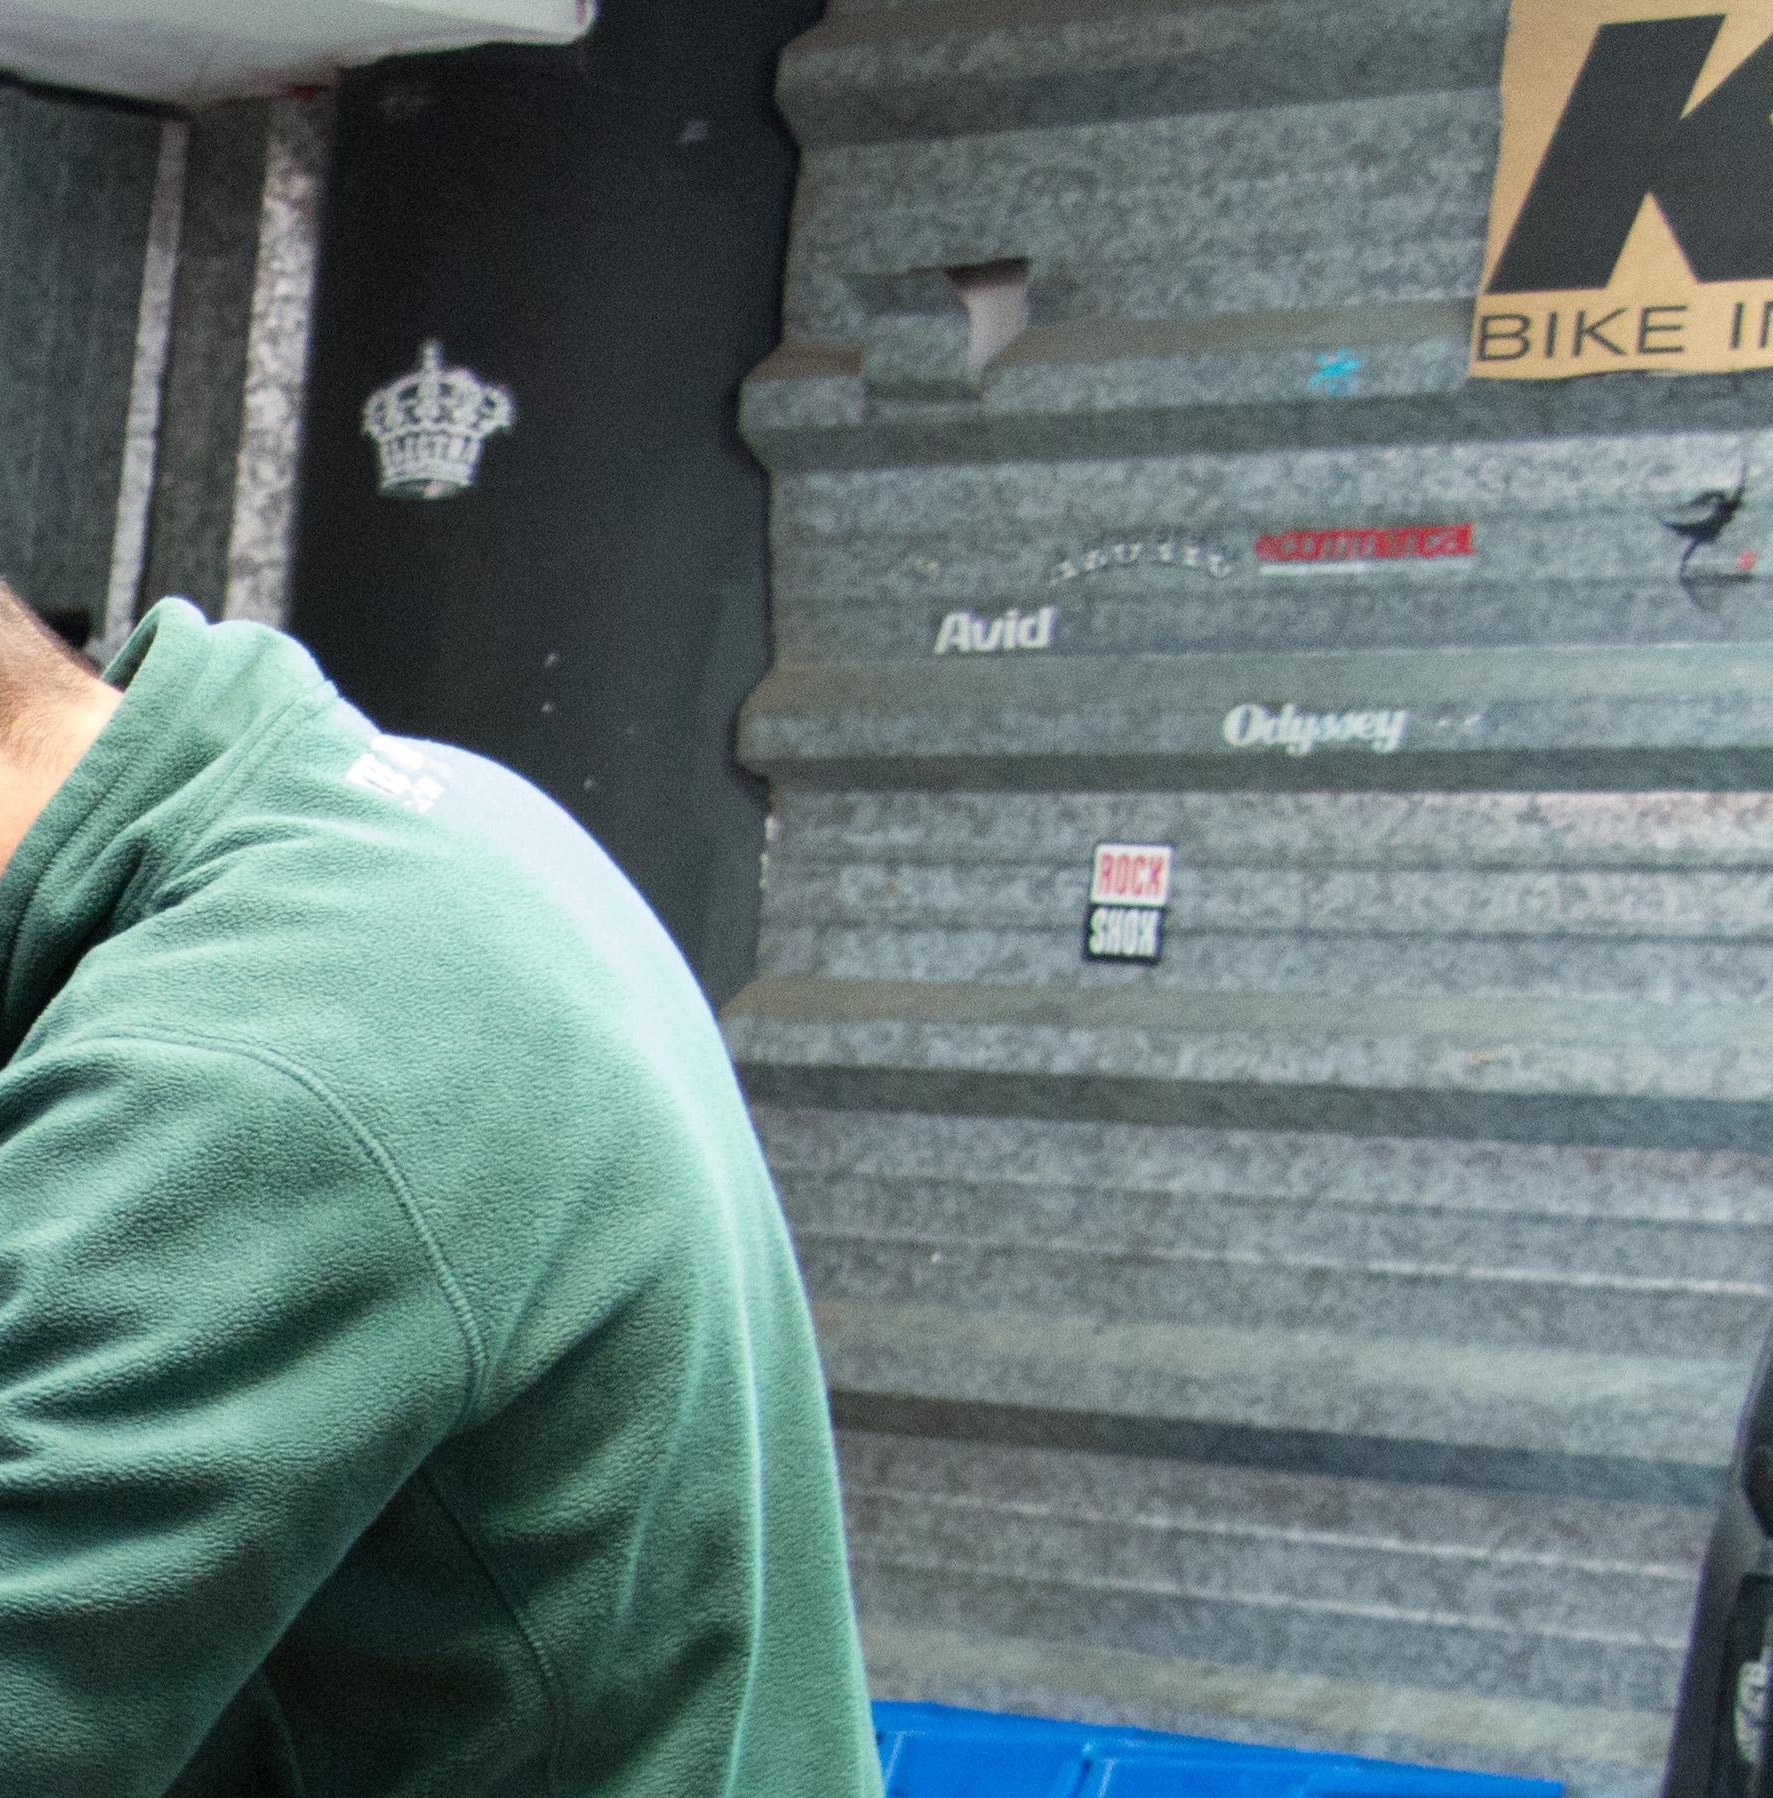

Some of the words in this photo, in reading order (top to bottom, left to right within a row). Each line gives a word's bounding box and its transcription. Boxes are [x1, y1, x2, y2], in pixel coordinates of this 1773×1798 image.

[1476, 304, 1688, 362] BIKE
[935, 606, 1055, 655] Avid
[1223, 703, 1408, 755] Odyssey
[1098, 853, 1164, 897] ROCK
[1089, 907, 1159, 957] SHOX
